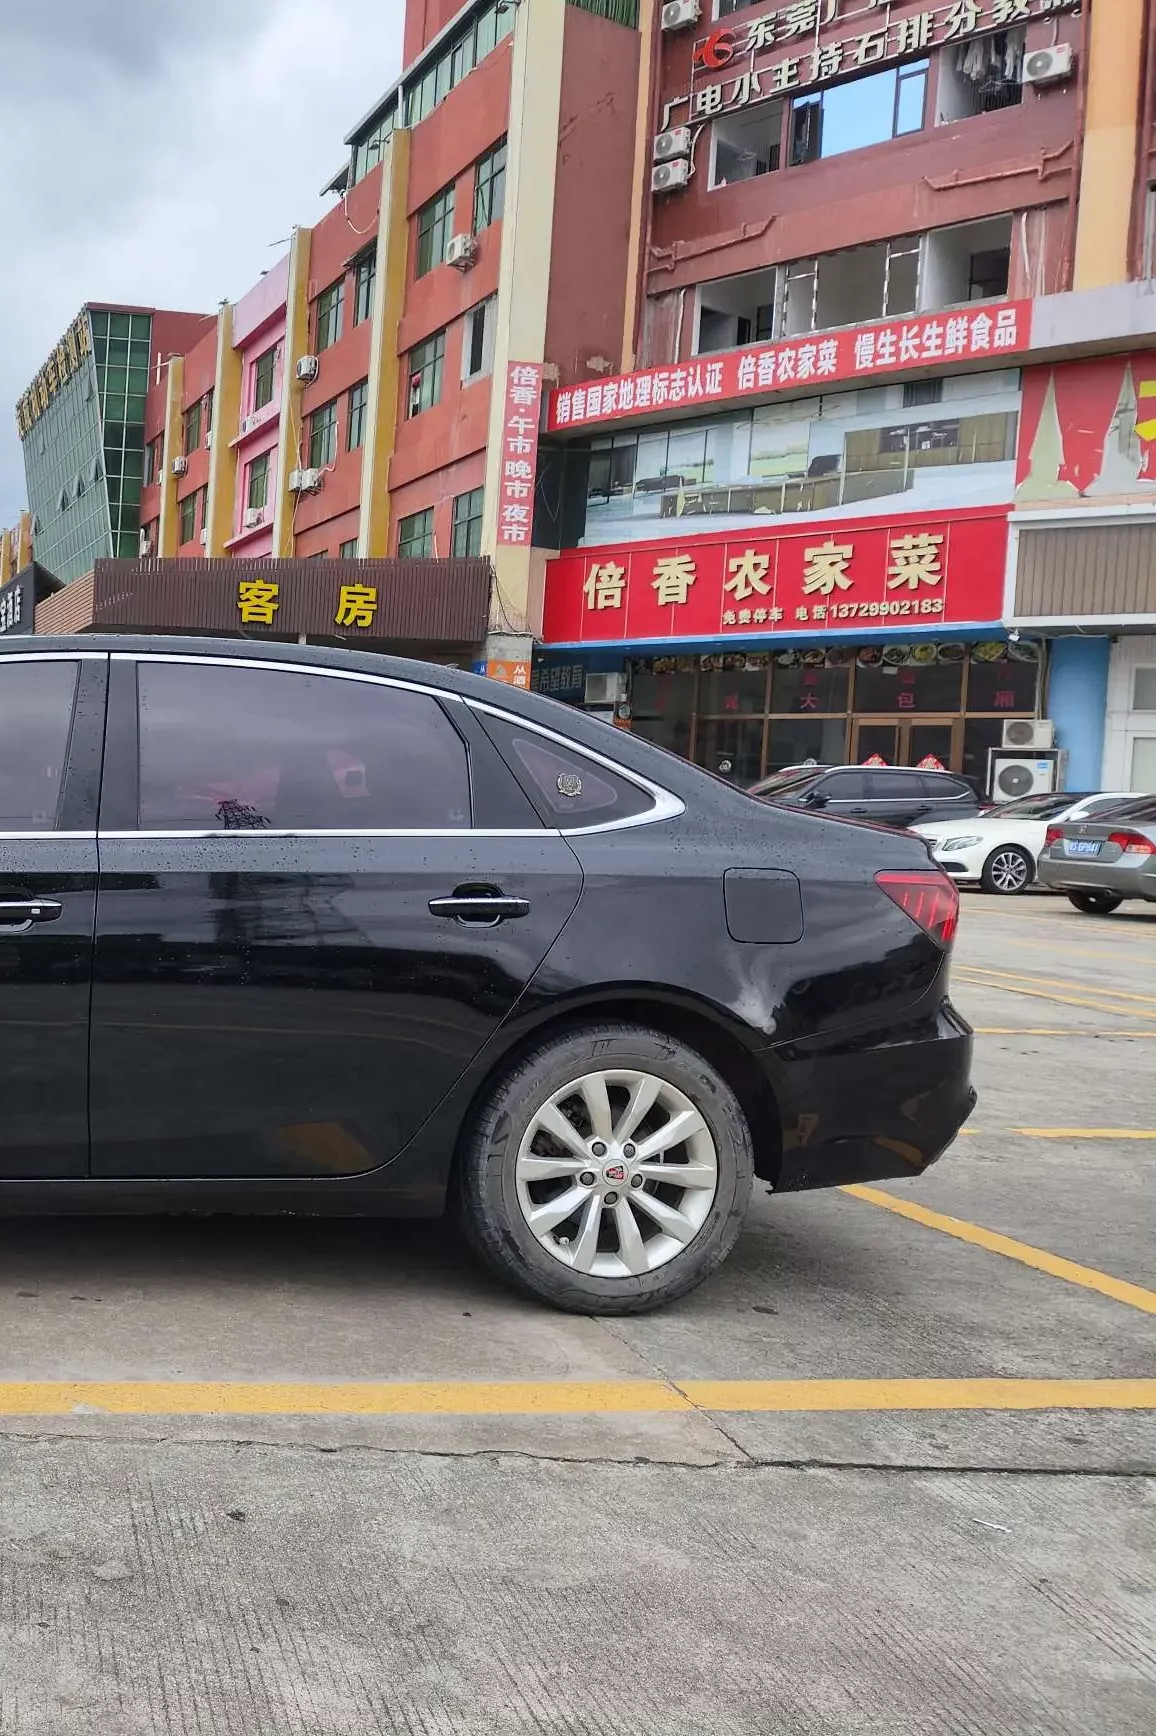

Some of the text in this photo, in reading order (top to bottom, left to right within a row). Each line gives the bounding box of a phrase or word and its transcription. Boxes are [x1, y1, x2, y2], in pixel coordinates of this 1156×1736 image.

[661, 0, 1081, 131] 广电小主持石排分教
[556, 308, 1016, 424] 销售国家地理标志认证 倍香农家菜 慢生长生鲜食品
[237, 578, 378, 627] 客房
[583, 532, 944, 610] 倍香农家菜
[723, 606, 784, 625] 免费停车
